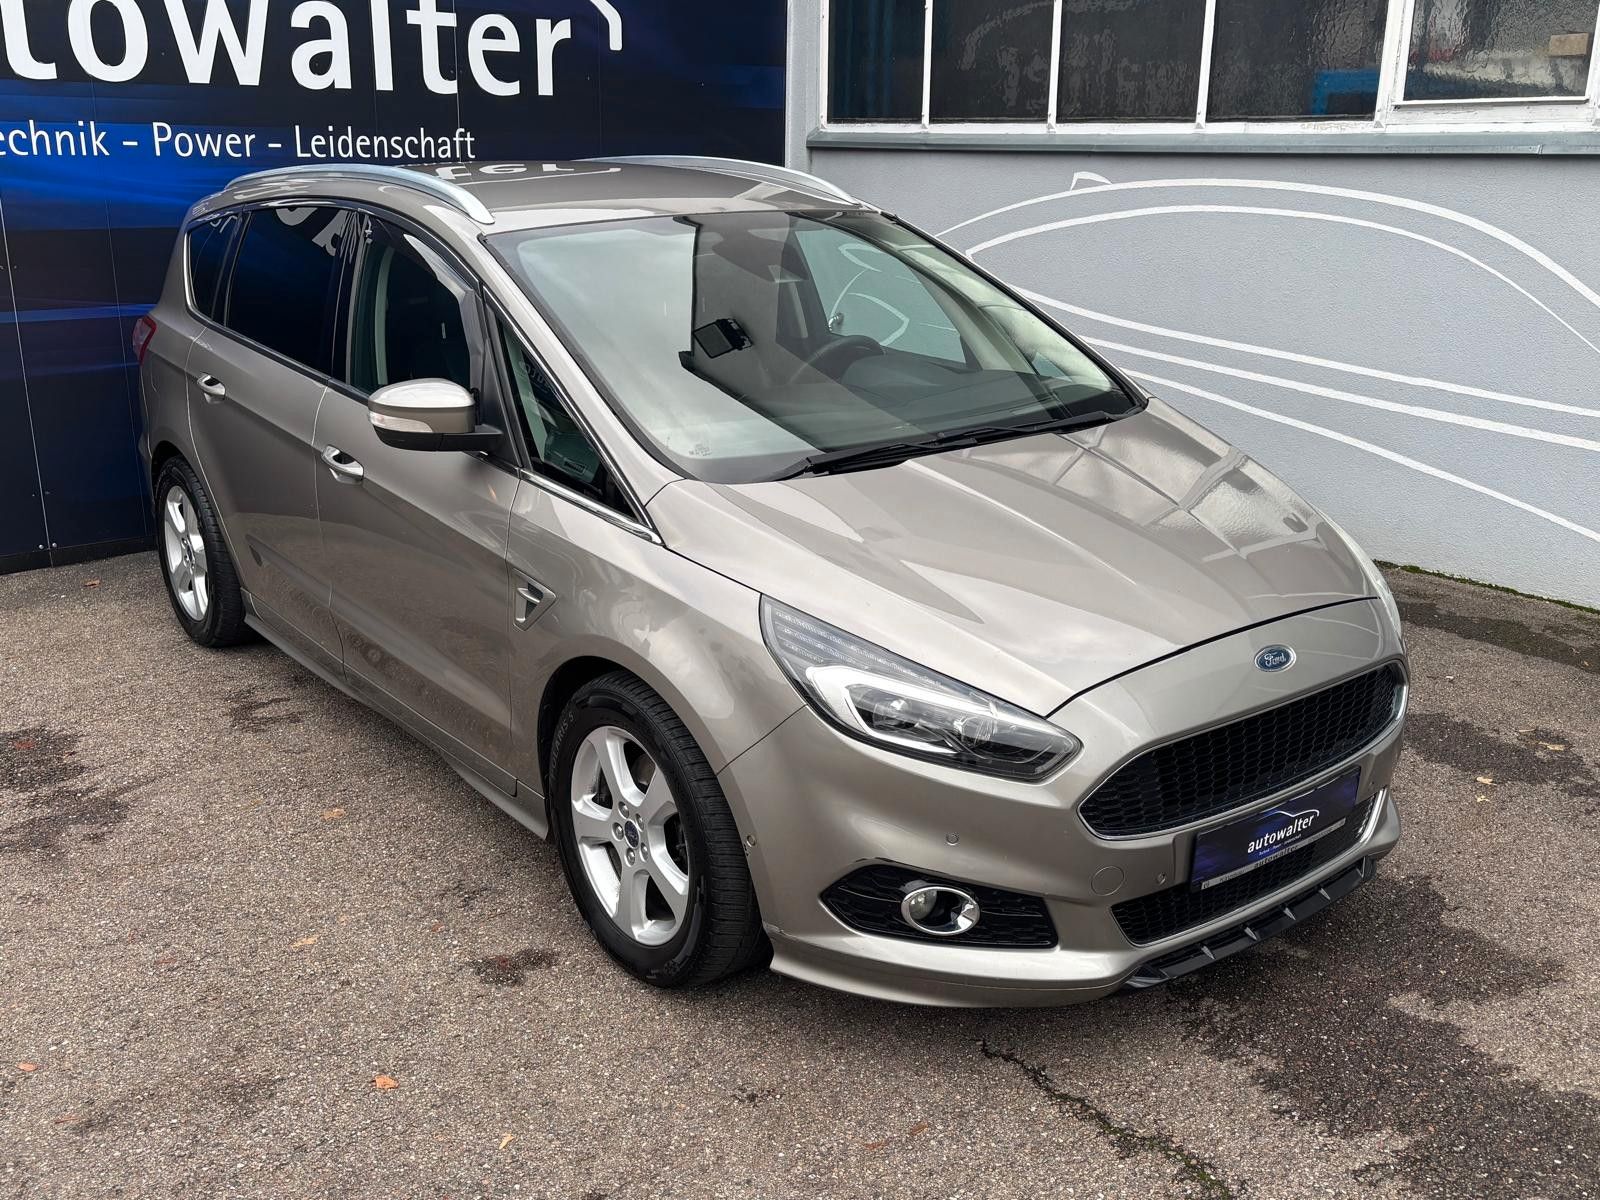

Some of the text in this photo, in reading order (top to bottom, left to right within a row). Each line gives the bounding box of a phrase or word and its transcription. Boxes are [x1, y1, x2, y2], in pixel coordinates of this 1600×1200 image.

[152, 122, 255, 157] Power
[294, 125, 475, 160] Leidenschaft
[1247, 814, 1315, 854] autowalter
